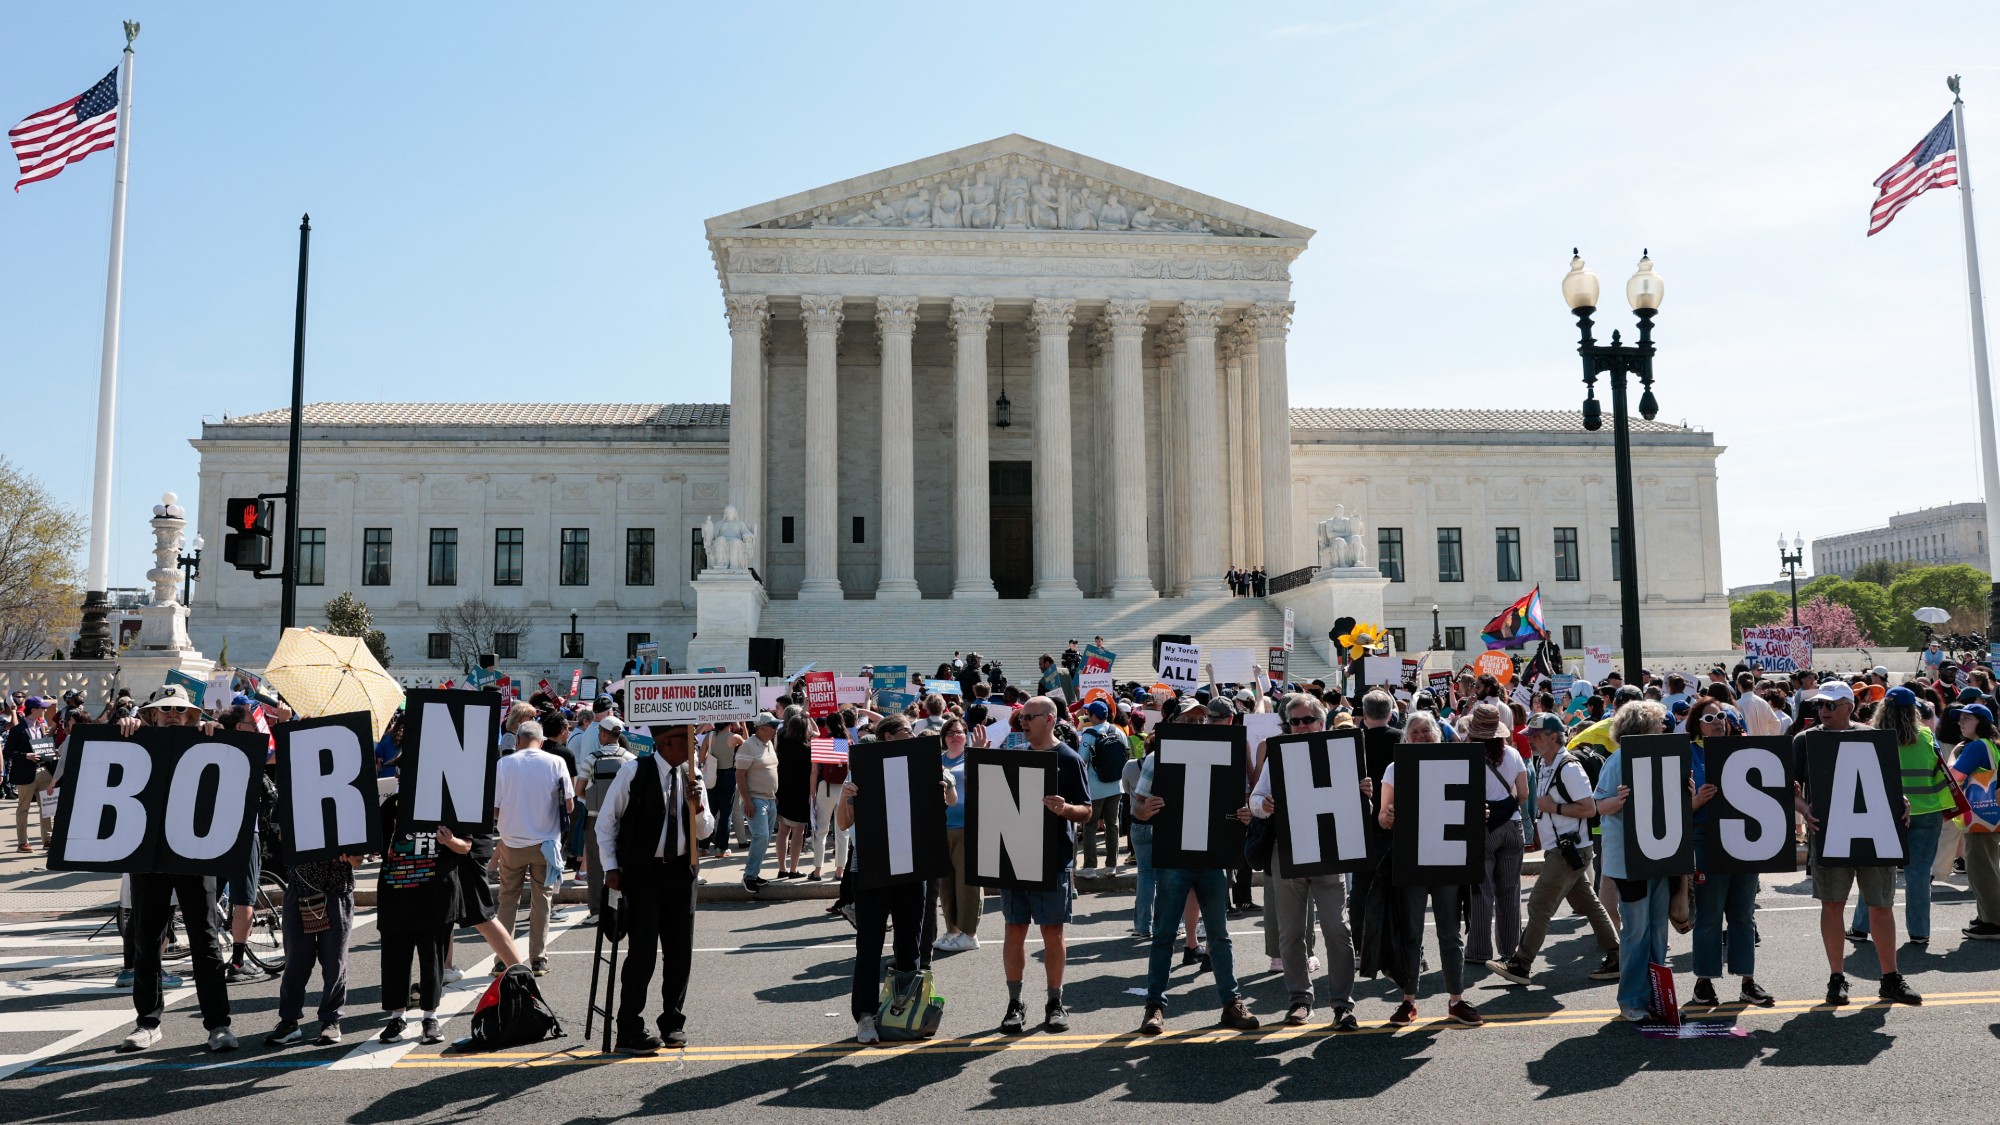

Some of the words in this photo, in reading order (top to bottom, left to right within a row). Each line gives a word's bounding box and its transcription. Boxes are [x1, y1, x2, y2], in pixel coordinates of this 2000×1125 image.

[1166, 646, 1176, 654] My
[1164, 656, 1198, 664] Welcomes
[1162, 666, 1196, 682] ALL
[635, 687, 659, 700] STOP
[662, 686, 696, 700] HATING
[698, 685, 721, 698] EACH
[724, 684, 752, 697] OTHER
[808, 681, 833, 692] BIRTH
[810, 692, 834, 703] RIGHT
[634, 702, 672, 714] BECAUSE
[675, 702, 692, 712] YOU
[694, 700, 740, 712] DISAGREE...
[1650, 967, 1662, 1016] AMENDMENT
